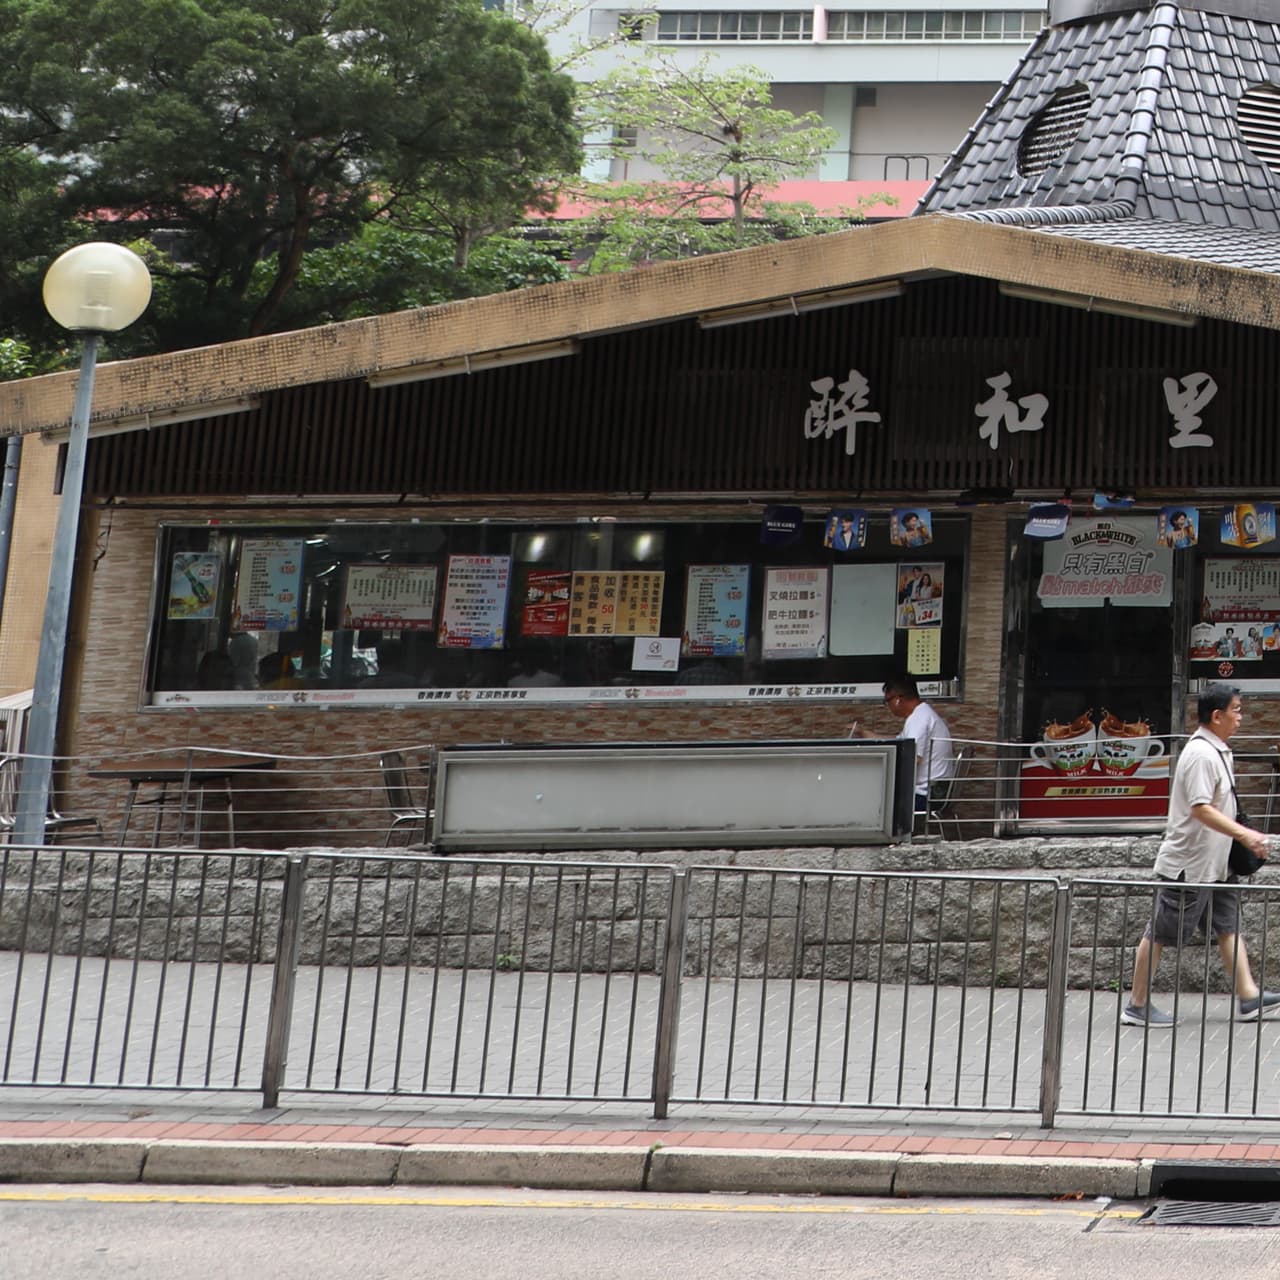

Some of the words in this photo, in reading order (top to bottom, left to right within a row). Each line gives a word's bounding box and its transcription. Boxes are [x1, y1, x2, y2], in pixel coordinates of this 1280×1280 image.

[804, 369, 1220, 455] 醉和里
[1061, 551, 1149, 576] 只有黑白
[1066, 768, 1087, 777] MILK
[1105, 768, 1125, 776] MILK
